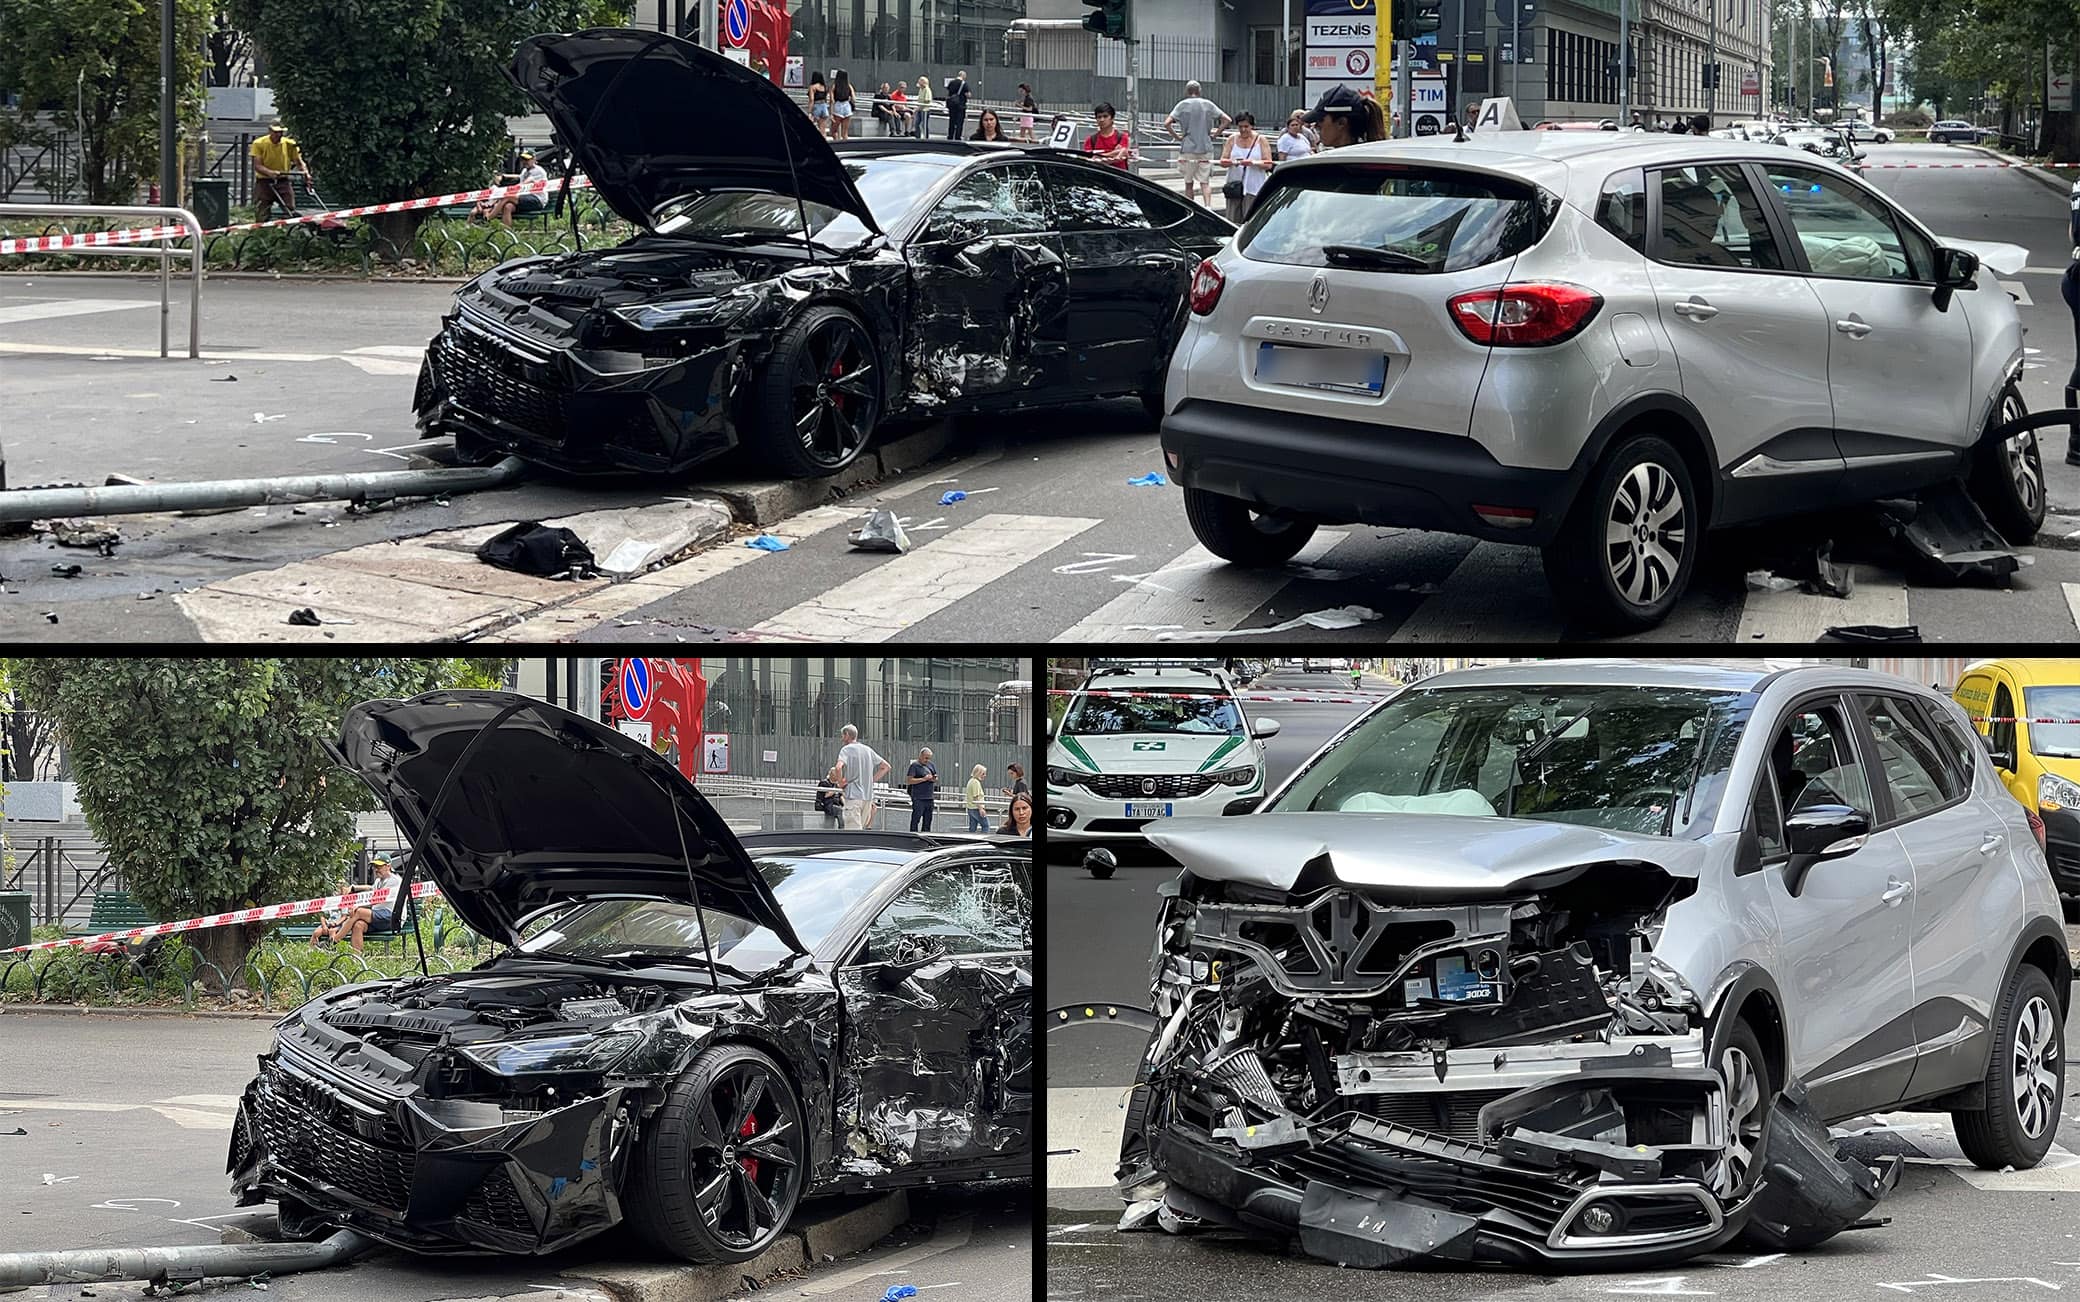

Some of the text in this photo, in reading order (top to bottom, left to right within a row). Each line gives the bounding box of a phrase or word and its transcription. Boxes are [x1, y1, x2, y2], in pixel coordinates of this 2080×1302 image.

[1419, 89, 1443, 101] TIM
[1480, 102, 1499, 126] A
[1054, 125, 1071, 142] B
[1264, 323, 1372, 346] CAPTUR
